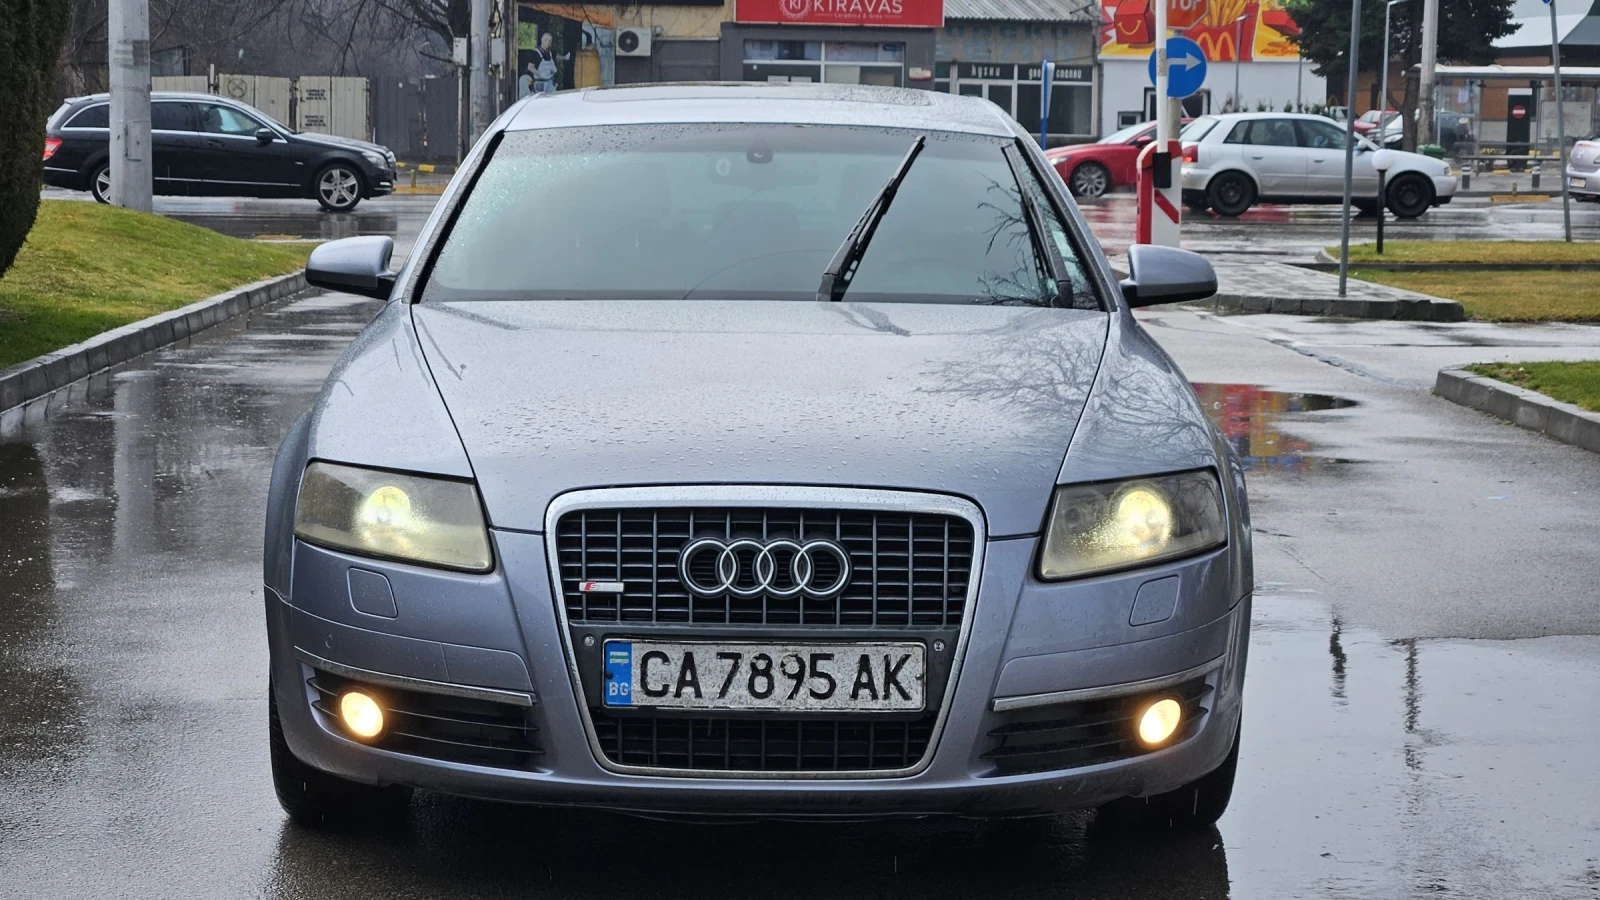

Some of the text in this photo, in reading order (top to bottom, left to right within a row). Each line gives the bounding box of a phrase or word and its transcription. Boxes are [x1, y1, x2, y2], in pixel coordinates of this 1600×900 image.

[814, 0, 903, 14] KIRAVAS
[640, 650, 913, 701] CA 7895 AK
[609, 681, 629, 696] BG
